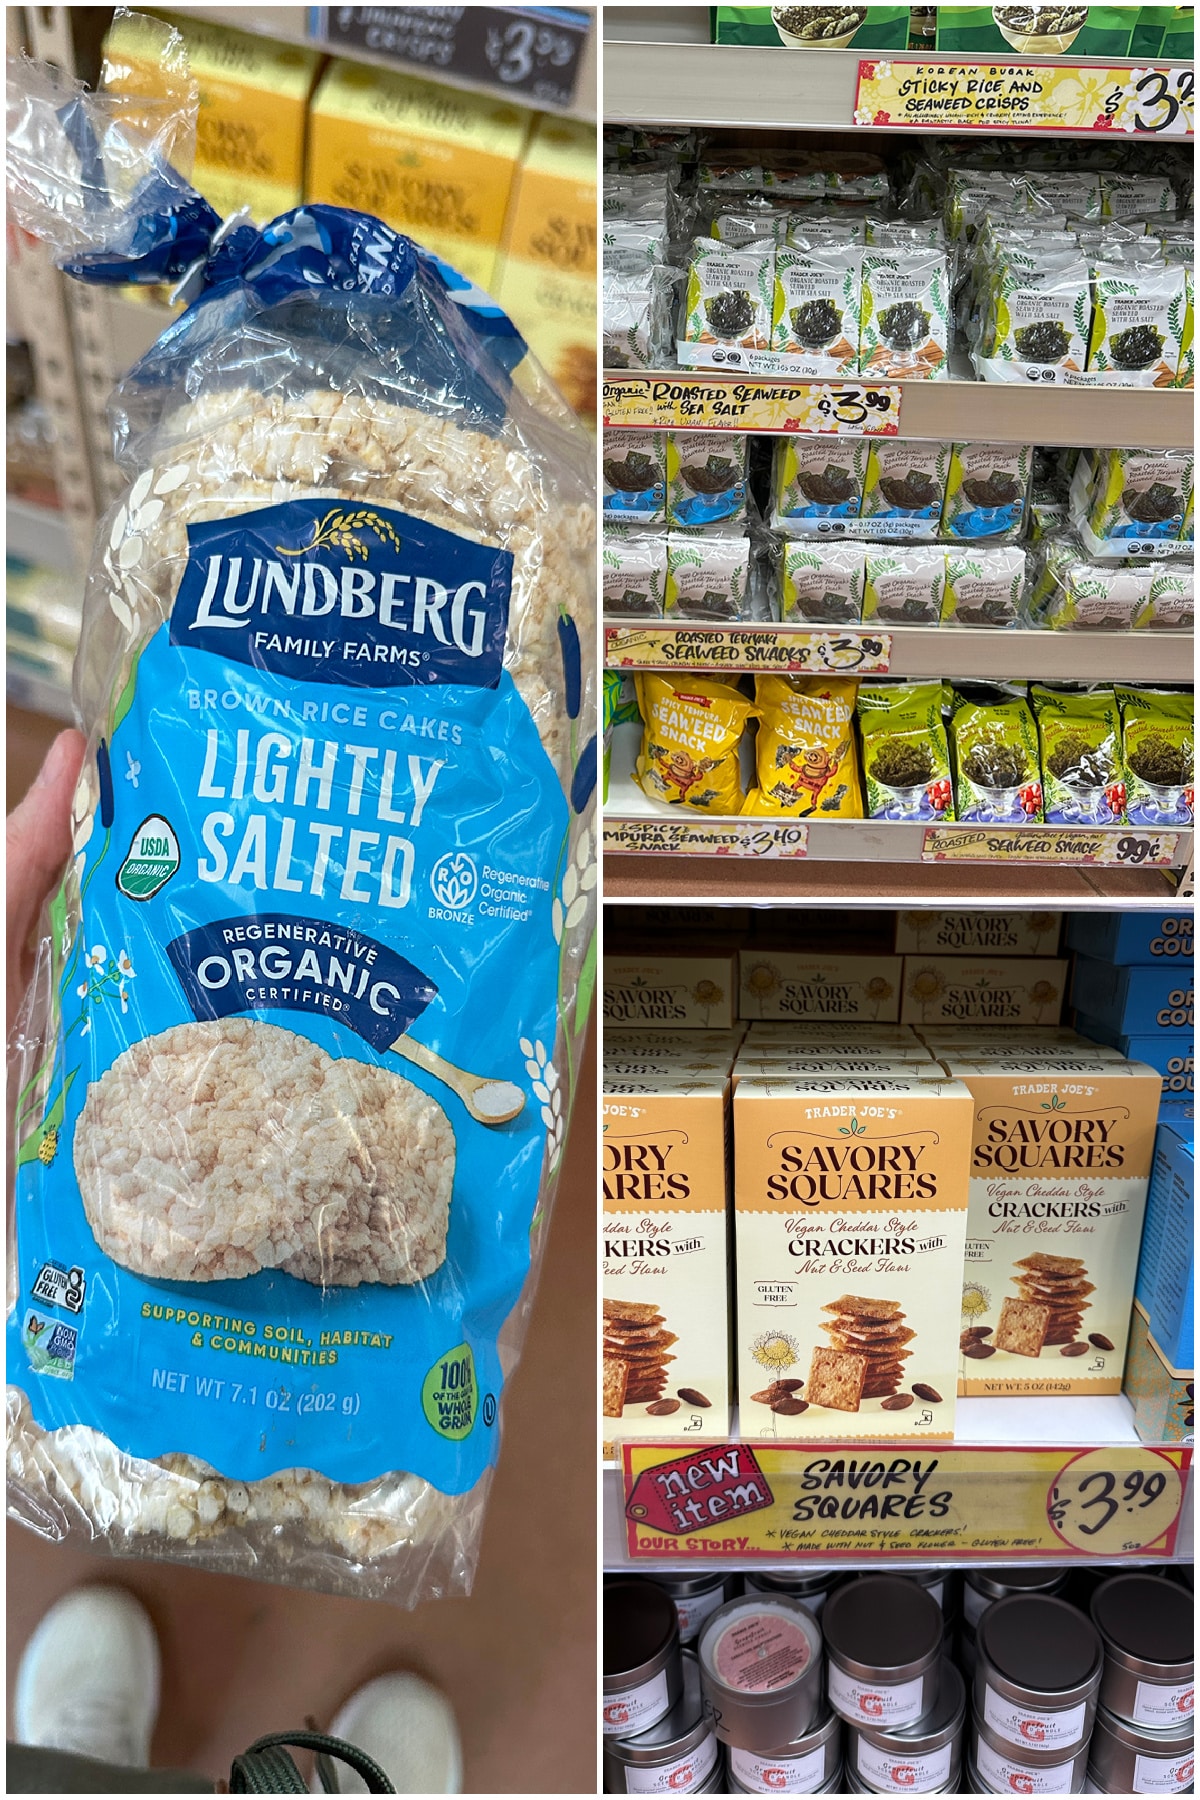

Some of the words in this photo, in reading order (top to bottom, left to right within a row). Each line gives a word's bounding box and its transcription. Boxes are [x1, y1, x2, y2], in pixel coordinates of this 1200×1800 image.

[916, 67, 978, 76] KOREAN
[989, 67, 1035, 76] BUGAK
[898, 79, 958, 97] STICKY
[967, 79, 1005, 95] RICE
[1009, 81, 1043, 95] AND
[905, 98, 972, 112] SEAWEED
[974, 95, 1030, 111] CRISPS
[653, 385, 727, 401] ROASTED
[733, 385, 801, 401] SEAWEED
[657, 401, 677, 411] with
[680, 402, 705, 415] SEA
[712, 403, 750, 416] SALT
[188, 554, 488, 658] LUNDBERG
[254, 632, 336, 659] FAMILY
[675, 631, 724, 644] ROASTED
[728, 632, 778, 646] TERIYAKI
[662, 643, 740, 660] SEAWEED
[745, 645, 810, 663] SNACKS
[188, 688, 291, 719] BROWN
[302, 700, 368, 727] RICE
[379, 711, 463, 746] CAKES
[661, 697, 682, 711] SPICY
[683, 703, 722, 723] TEMPURA
[652, 703, 727, 742] SEAWEED
[660, 725, 706, 753] SNACK
[197, 729, 446, 828] LIGHTLY
[141, 836, 170, 857] USDA
[602, 831, 664, 843] MPURA
[668, 834, 740, 845] SEAWEED
[626, 842, 681, 851] SNACK
[931, 832, 986, 850] ROASTED
[987, 838, 1052, 853] SEAWEED
[1055, 839, 1103, 854] SNACK
[1116, 836, 1160, 863] 99¢
[197, 811, 417, 909] SALTED
[126, 862, 170, 878] ORGANIC
[480, 883, 528, 904] Organic
[428, 906, 475, 926] BRONZE
[944, 916, 1014, 933] SAVORY
[222, 922, 379, 966] REGENERATIVE
[937, 931, 1018, 948] SQUARES
[197, 946, 402, 1017] ORGANIC
[785, 985, 853, 1001] SAVORY
[779, 999, 859, 1016] SQUARES
[1012, 1083, 1058, 1096] TRADER
[1061, 1084, 1095, 1096] JOE'S
[805, 1106, 857, 1120] TRADER
[860, 1106, 898, 1119] JOE'S
[987, 1119, 1118, 1142] SAVORY
[781, 1145, 926, 1172] SAVORY
[973, 1144, 1125, 1173] SQUARES
[767, 1173, 938, 1206] SQUARES
[986, 1183, 1023, 1200] Vegan
[1026, 1184, 1070, 1197] Cheddar
[1074, 1184, 1105, 1200] Style
[988, 1202, 1101, 1218] CRACKERS
[784, 1217, 826, 1237] Vegan
[829, 1218, 881, 1234] Cheddar
[883, 1217, 919, 1237] Style
[788, 1238, 916, 1257] CRACKERS
[919, 1237, 944, 1252] with
[795, 1259, 829, 1275] Nut
[830, 1260, 842, 1275] &
[841, 1260, 872, 1275] Seed
[875, 1257, 912, 1275] Flour
[42, 1267, 68, 1290] GLUTEN
[36, 1281, 58, 1299] FREE
[757, 1285, 794, 1294] GLUTEN
[763, 1294, 788, 1303] FREE
[56, 1325, 76, 1342] NON
[141, 1302, 257, 1337] SUPPORTING
[263, 1325, 313, 1348] SOIL,
[320, 1330, 394, 1349] HABITAT
[53, 1336, 75, 1351] GMO
[191, 1332, 204, 1348] &
[210, 1335, 338, 1367] COMMUNITIES
[152, 1368, 190, 1394] NET
[195, 1376, 226, 1400] WT
[231, 1382, 258, 1407] 7.1
[265, 1390, 291, 1413] OZ
[296, 1392, 336, 1416] (202
[341, 1391, 362, 1417] g)
[433, 1391, 445, 1401] OF
[446, 1391, 460, 1401] THE
[984, 1383, 1002, 1391] NET
[1005, 1383, 1023, 1391] WT.
[1023, 1383, 1030, 1391] 5
[1031, 1383, 1045, 1391] OZ
[1045, 1383, 1072, 1392] (142g)
[438, 1400, 471, 1416] WHOLE
[439, 1412, 472, 1431] GRAIN
[657, 1451, 740, 1499] new
[800, 1459, 938, 1494] SAVORY
[671, 1480, 765, 1529] item
[793, 1491, 952, 1521] SQUARES
[779, 1529, 816, 1538] VEGAN
[821, 1529, 868, 1538] CHEDDAR
[871, 1529, 901, 1538] STYLE
[910, 1525, 968, 1537] CRACKERS!
[639, 1536, 678, 1550] OUR
[685, 1536, 760, 1550] STORY...
[796, 1543, 820, 1551] MADE
[826, 1542, 852, 1550] WITH
[971, 1539, 1010, 1547] GLUTEN
[1012, 1537, 1042, 1548] FREE!
